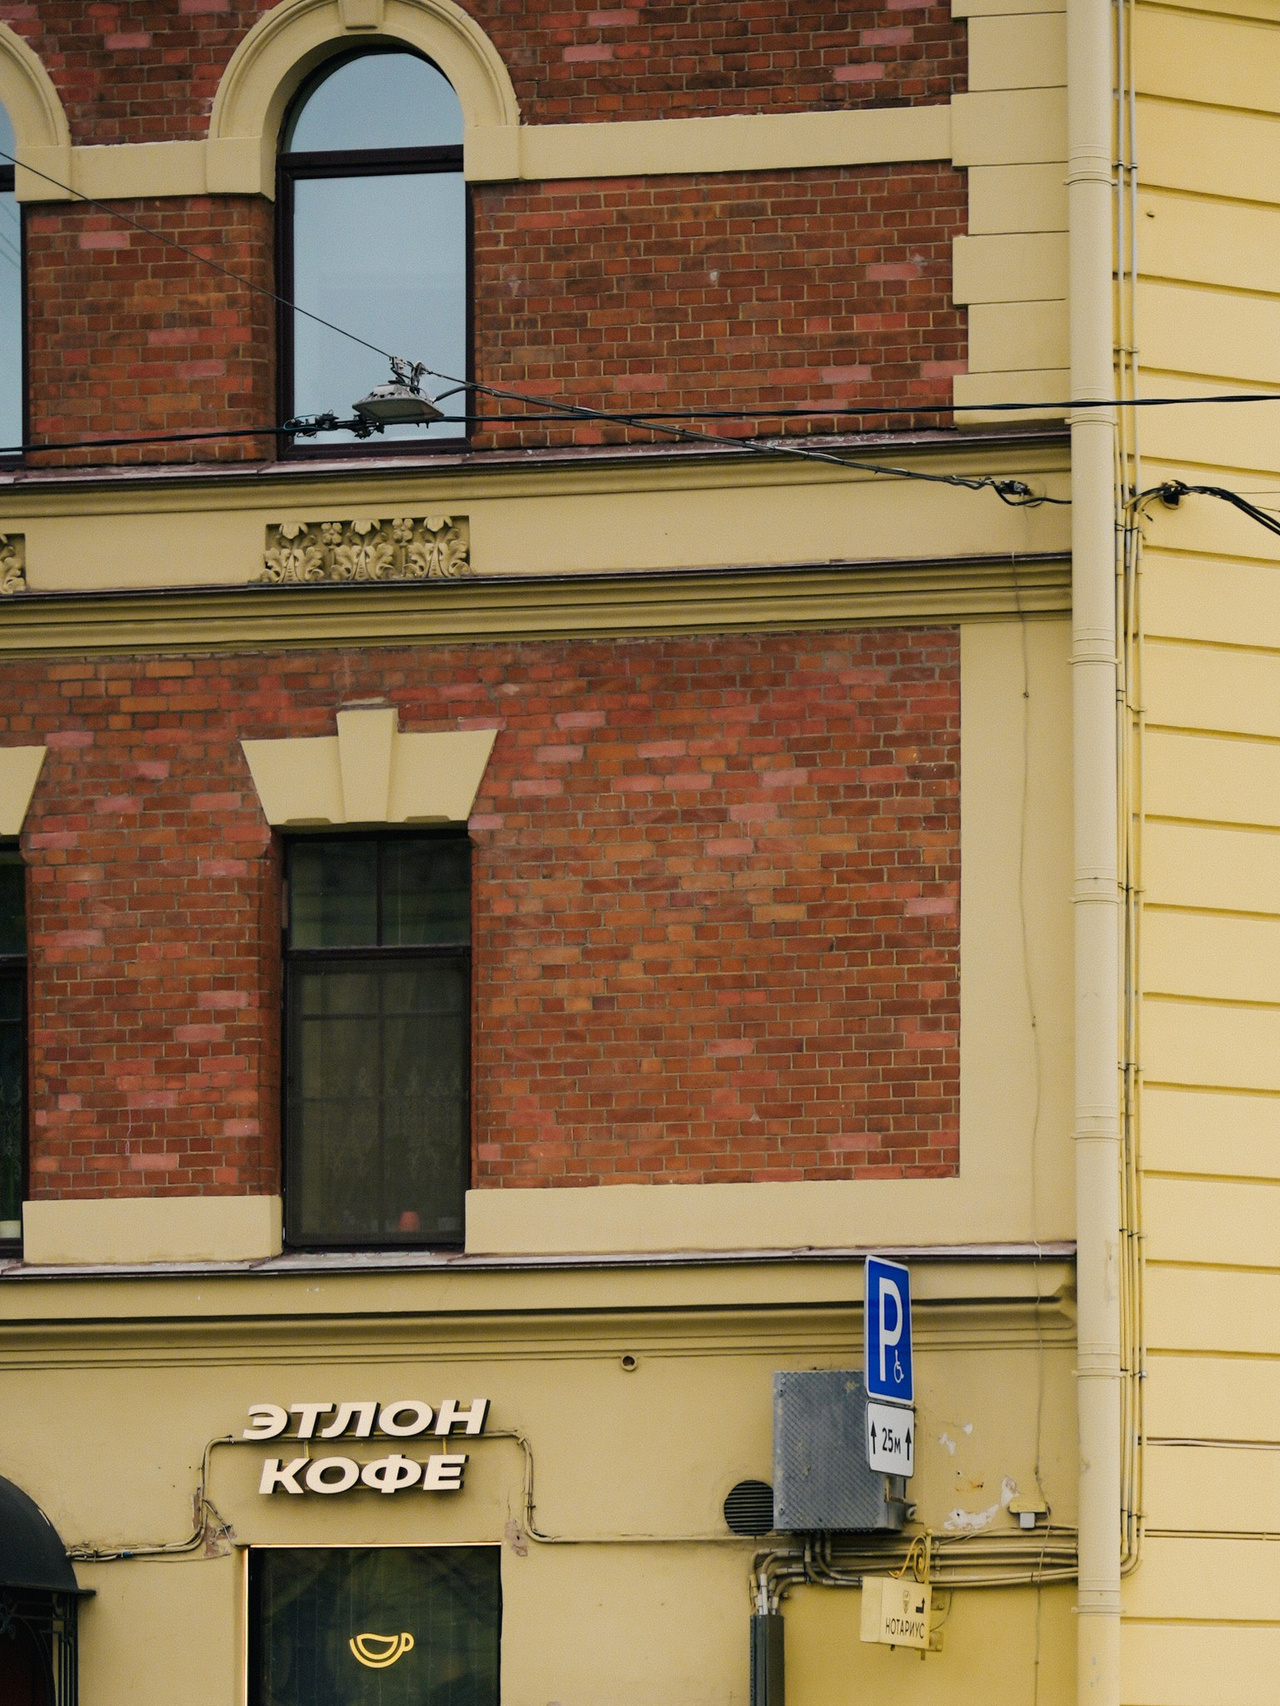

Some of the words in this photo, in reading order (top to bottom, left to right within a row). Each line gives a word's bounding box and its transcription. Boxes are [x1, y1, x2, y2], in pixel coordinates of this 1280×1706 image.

[878, 1276, 904, 1382] P
[242, 1398, 491, 1441] ЭТЛОН
[258, 1454, 470, 1495] КОФЕ
[885, 1617, 926, 1639] НОТАРИУС
